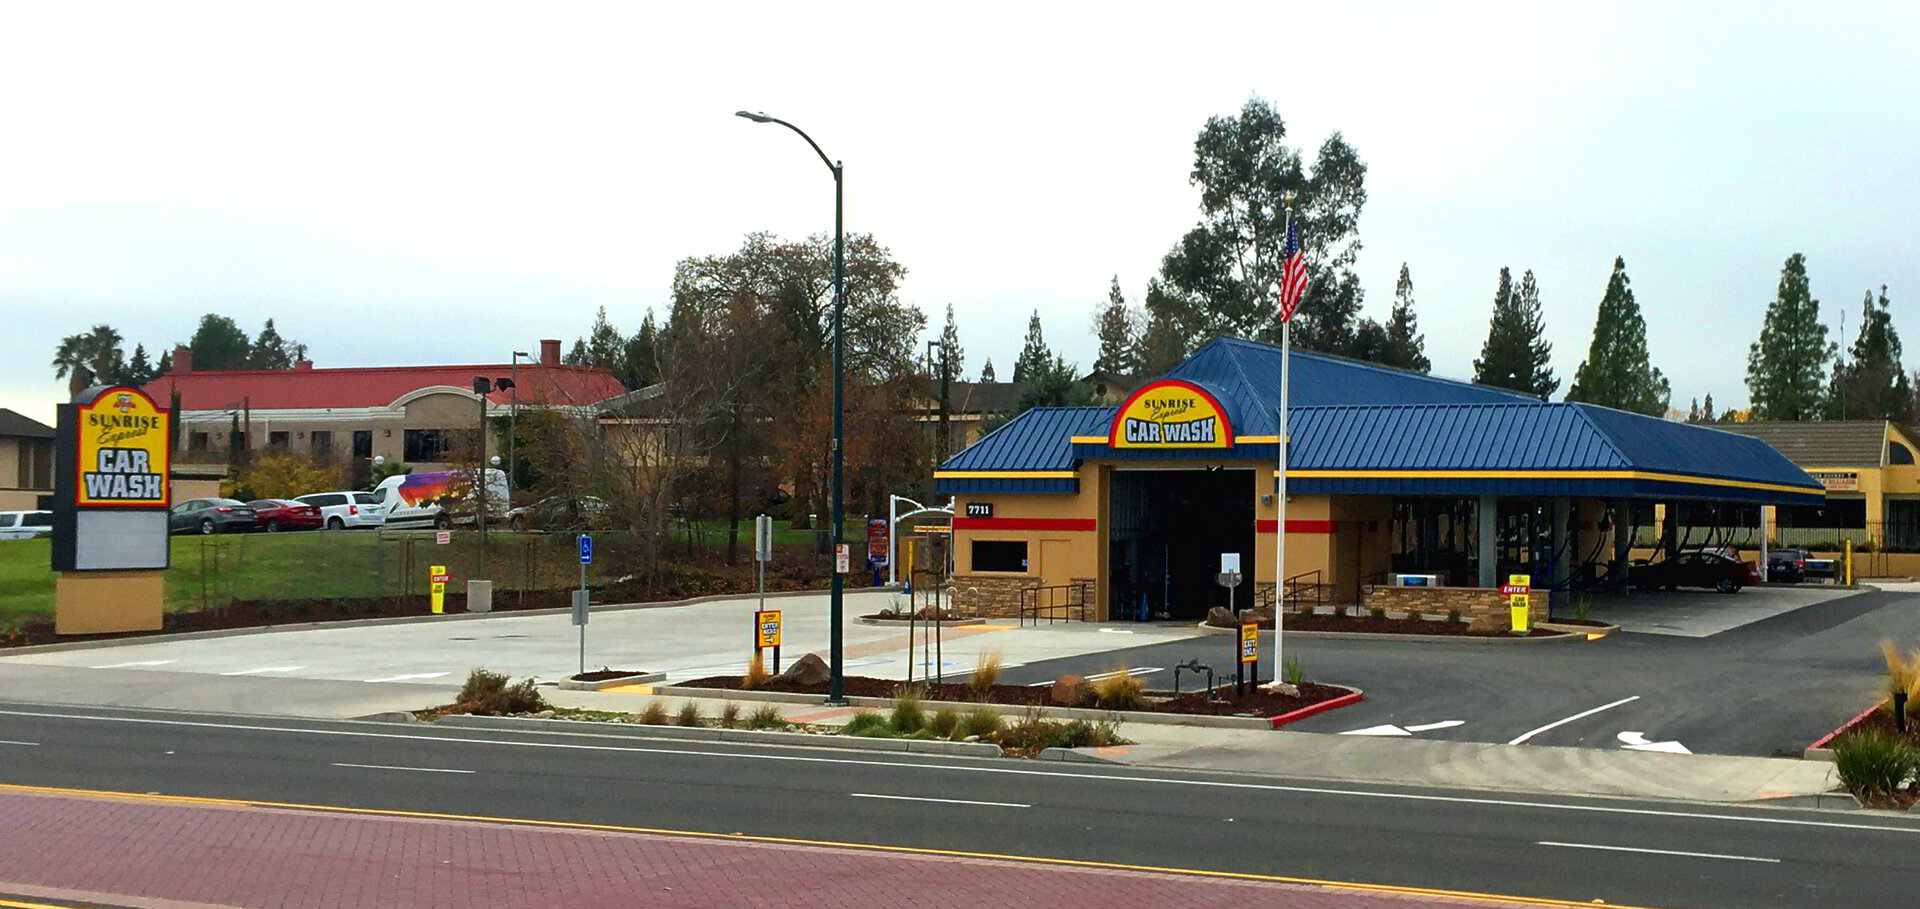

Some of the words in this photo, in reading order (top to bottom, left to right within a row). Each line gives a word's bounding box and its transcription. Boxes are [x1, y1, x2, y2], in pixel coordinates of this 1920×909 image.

[1144, 398, 1197, 409] SUNRISE
[90, 413, 159, 429] SUNRISE
[1150, 405, 1188, 421] Express
[1127, 418, 1160, 442] CAR
[1163, 416, 1215, 442] WASH
[99, 449, 149, 474] CAR
[85, 473, 161, 499] WASH
[968, 505, 989, 515] 7711
